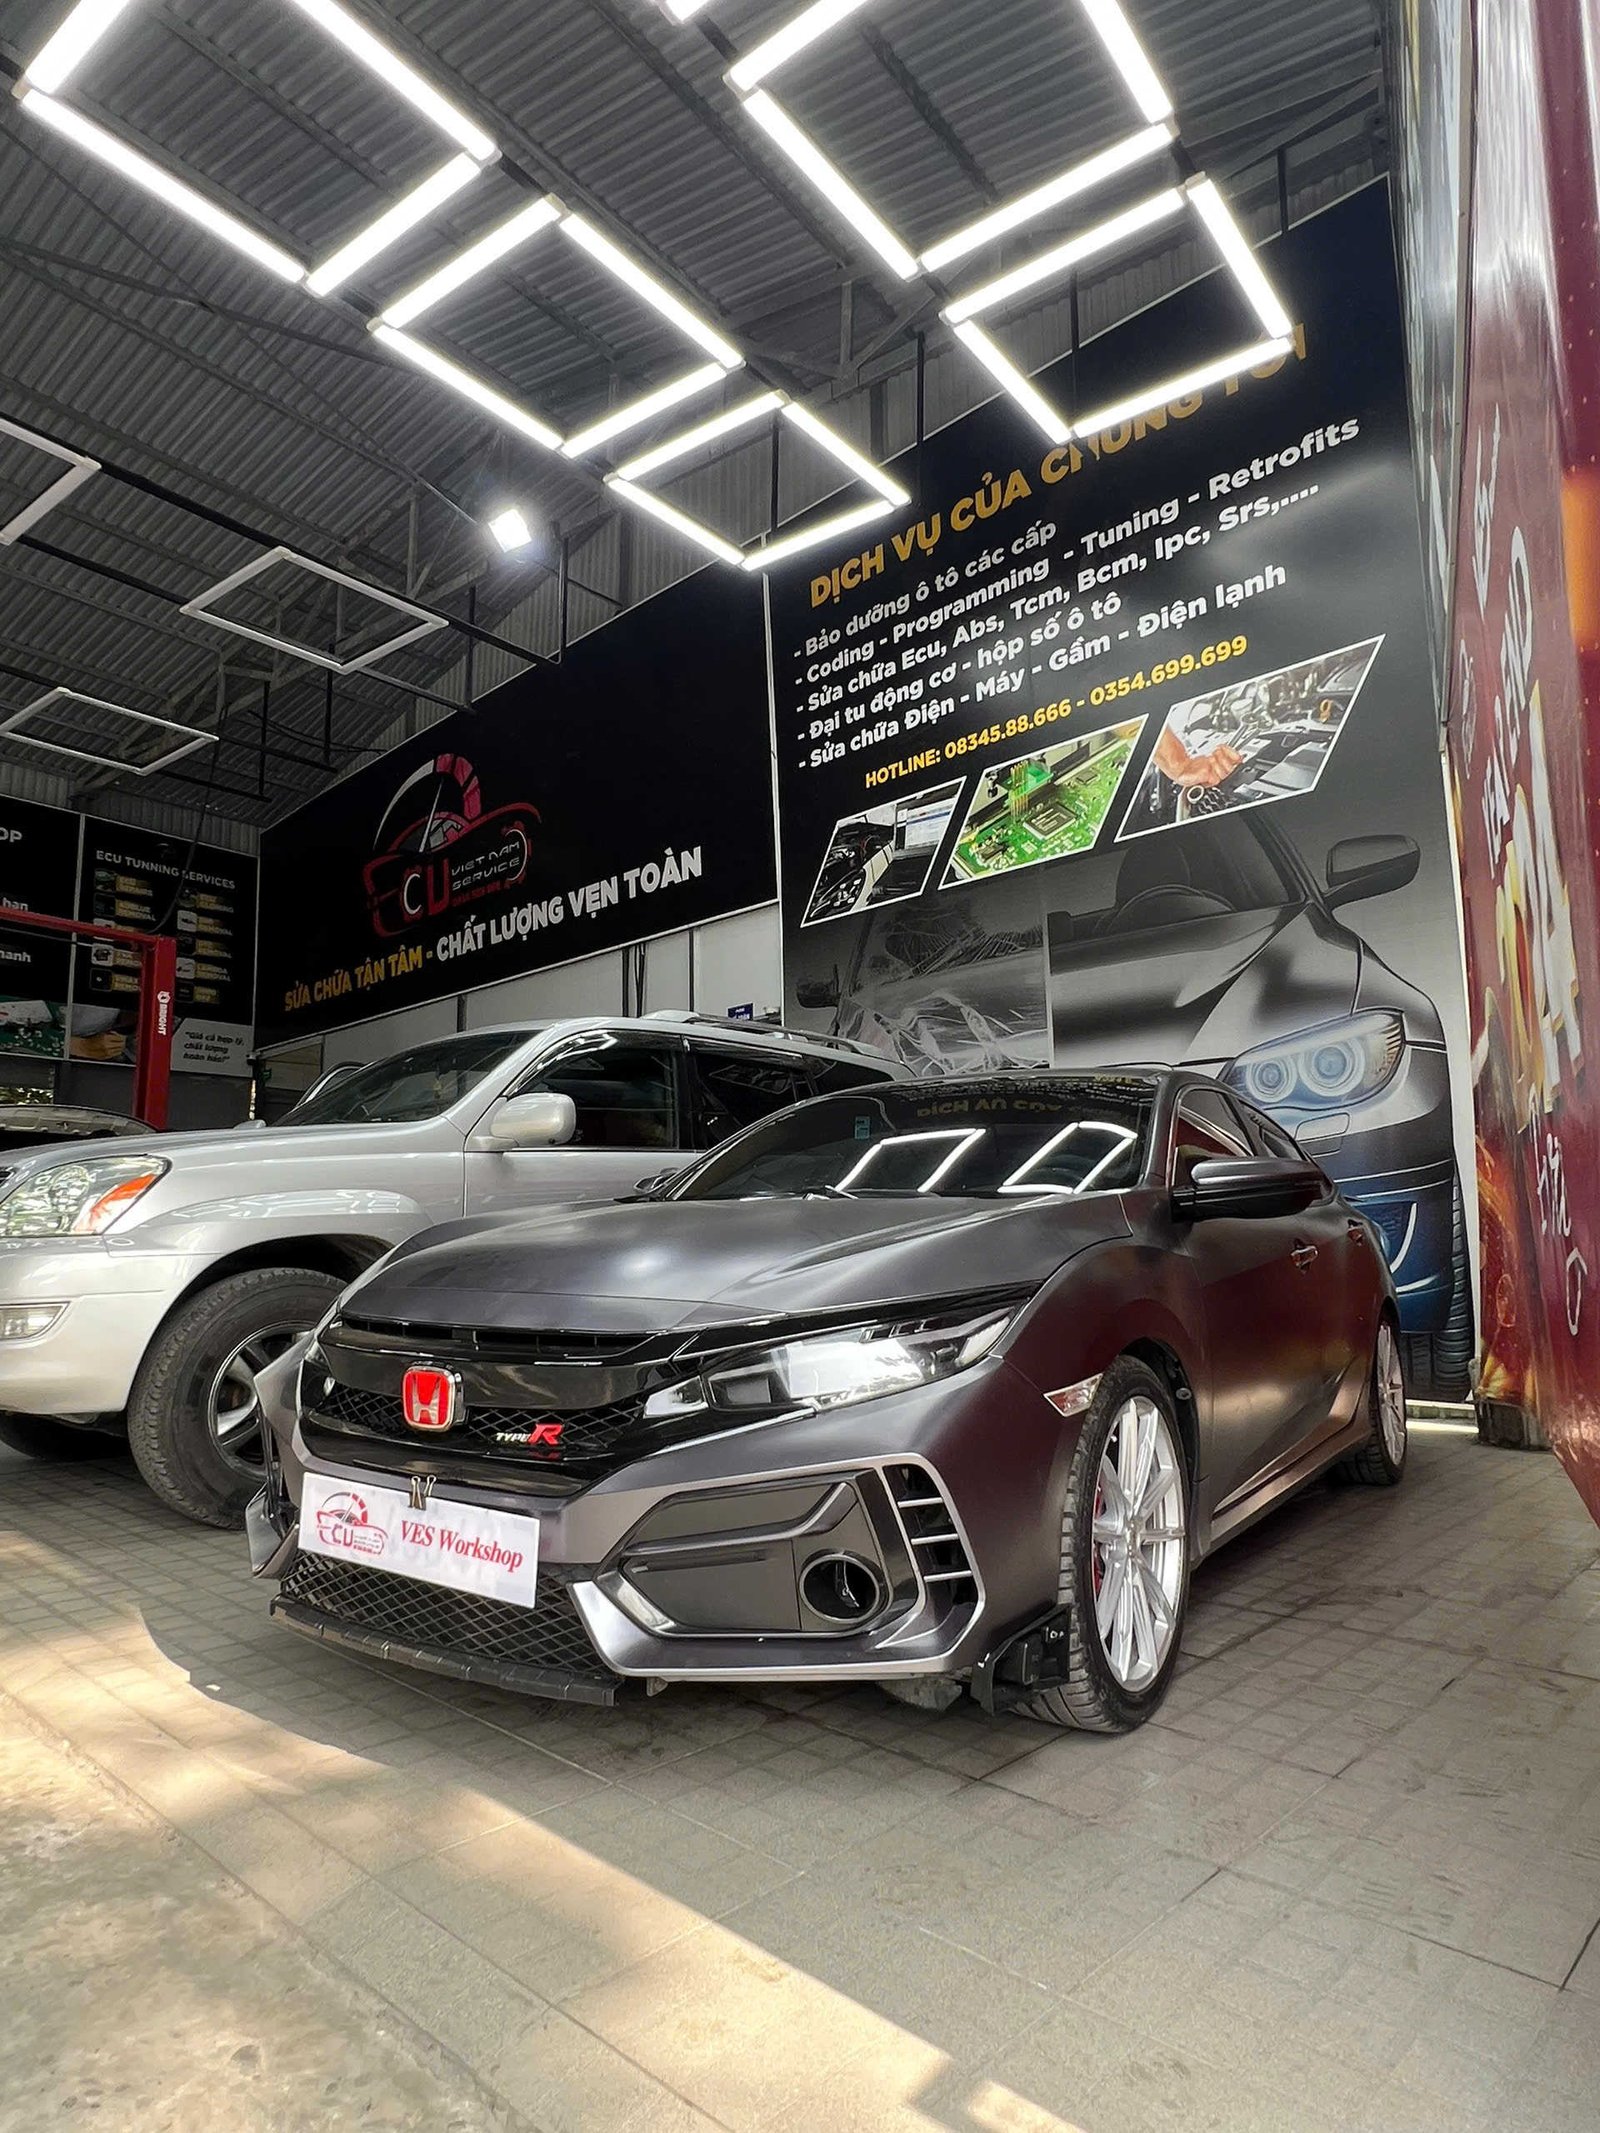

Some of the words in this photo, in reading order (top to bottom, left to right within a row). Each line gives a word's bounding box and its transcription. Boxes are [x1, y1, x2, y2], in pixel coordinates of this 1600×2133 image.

[805, 628, 841, 657] Bảo
[845, 594, 910, 637] dưỡng
[915, 580, 929, 601] ô
[935, 566, 959, 592] tô
[965, 550, 1005, 578] các
[1011, 520, 1056, 555] cấp
[806, 640, 874, 683] Coding
[893, 558, 1049, 644] Programming
[1081, 499, 1179, 555] Tuning
[1208, 418, 1360, 500] Retrofits
[810, 543, 885, 608] DỊCH
[891, 512, 941, 562] VỤ
[950, 468, 1032, 531] CỦA
[808, 684, 843, 711] Sửa
[847, 661, 897, 693] chữa
[901, 640, 947, 671] Ecu,
[952, 614, 1005, 648] Abs,
[1010, 585, 1071, 621] Tcm,
[1077, 552, 1147, 593] Bcm,
[1155, 525, 1211, 560] Ipc,
[809, 711, 840, 740] Đại
[844, 704, 865, 724] tu
[870, 678, 924, 713] động
[928, 662, 956, 688] cơ
[977, 636, 1024, 669] hộp
[1030, 611, 1062, 646] số
[1067, 606, 1084, 630] ô
[1091, 591, 1121, 620] tô
[810, 741, 845, 768] Sửa
[850, 720, 899, 751] chữa
[904, 697, 955, 730] Điện
[976, 668, 1025, 702] Máy
[1049, 636, 1111, 671] Gầm
[1137, 600, 1207, 638] Điện
[1215, 564, 1286, 609] lạnh
[865, 748, 941, 789] HOTLINE:
[944, 698, 1072, 759] 08345.88.666
[1090, 634, 1247, 706] 0354.699.699
[96, 850, 122, 863] ECU
[125, 857, 179, 877] TUNNING
[182, 870, 236, 889] SERVICES
[354, 957, 385, 990] TẬN
[388, 944, 423, 977] TÂM
[436, 914, 486, 961] CHẤT
[490, 896, 564, 941] LƯỢNG
[568, 876, 619, 918] VẸN
[623, 846, 702, 899] TOÀN
[451, 856, 521, 891] SERVICE
[496, 1432, 531, 1443] TYPE
[527, 1423, 564, 1446] R
[401, 1519, 435, 1547] VES
[439, 1528, 524, 1573] Workshop
